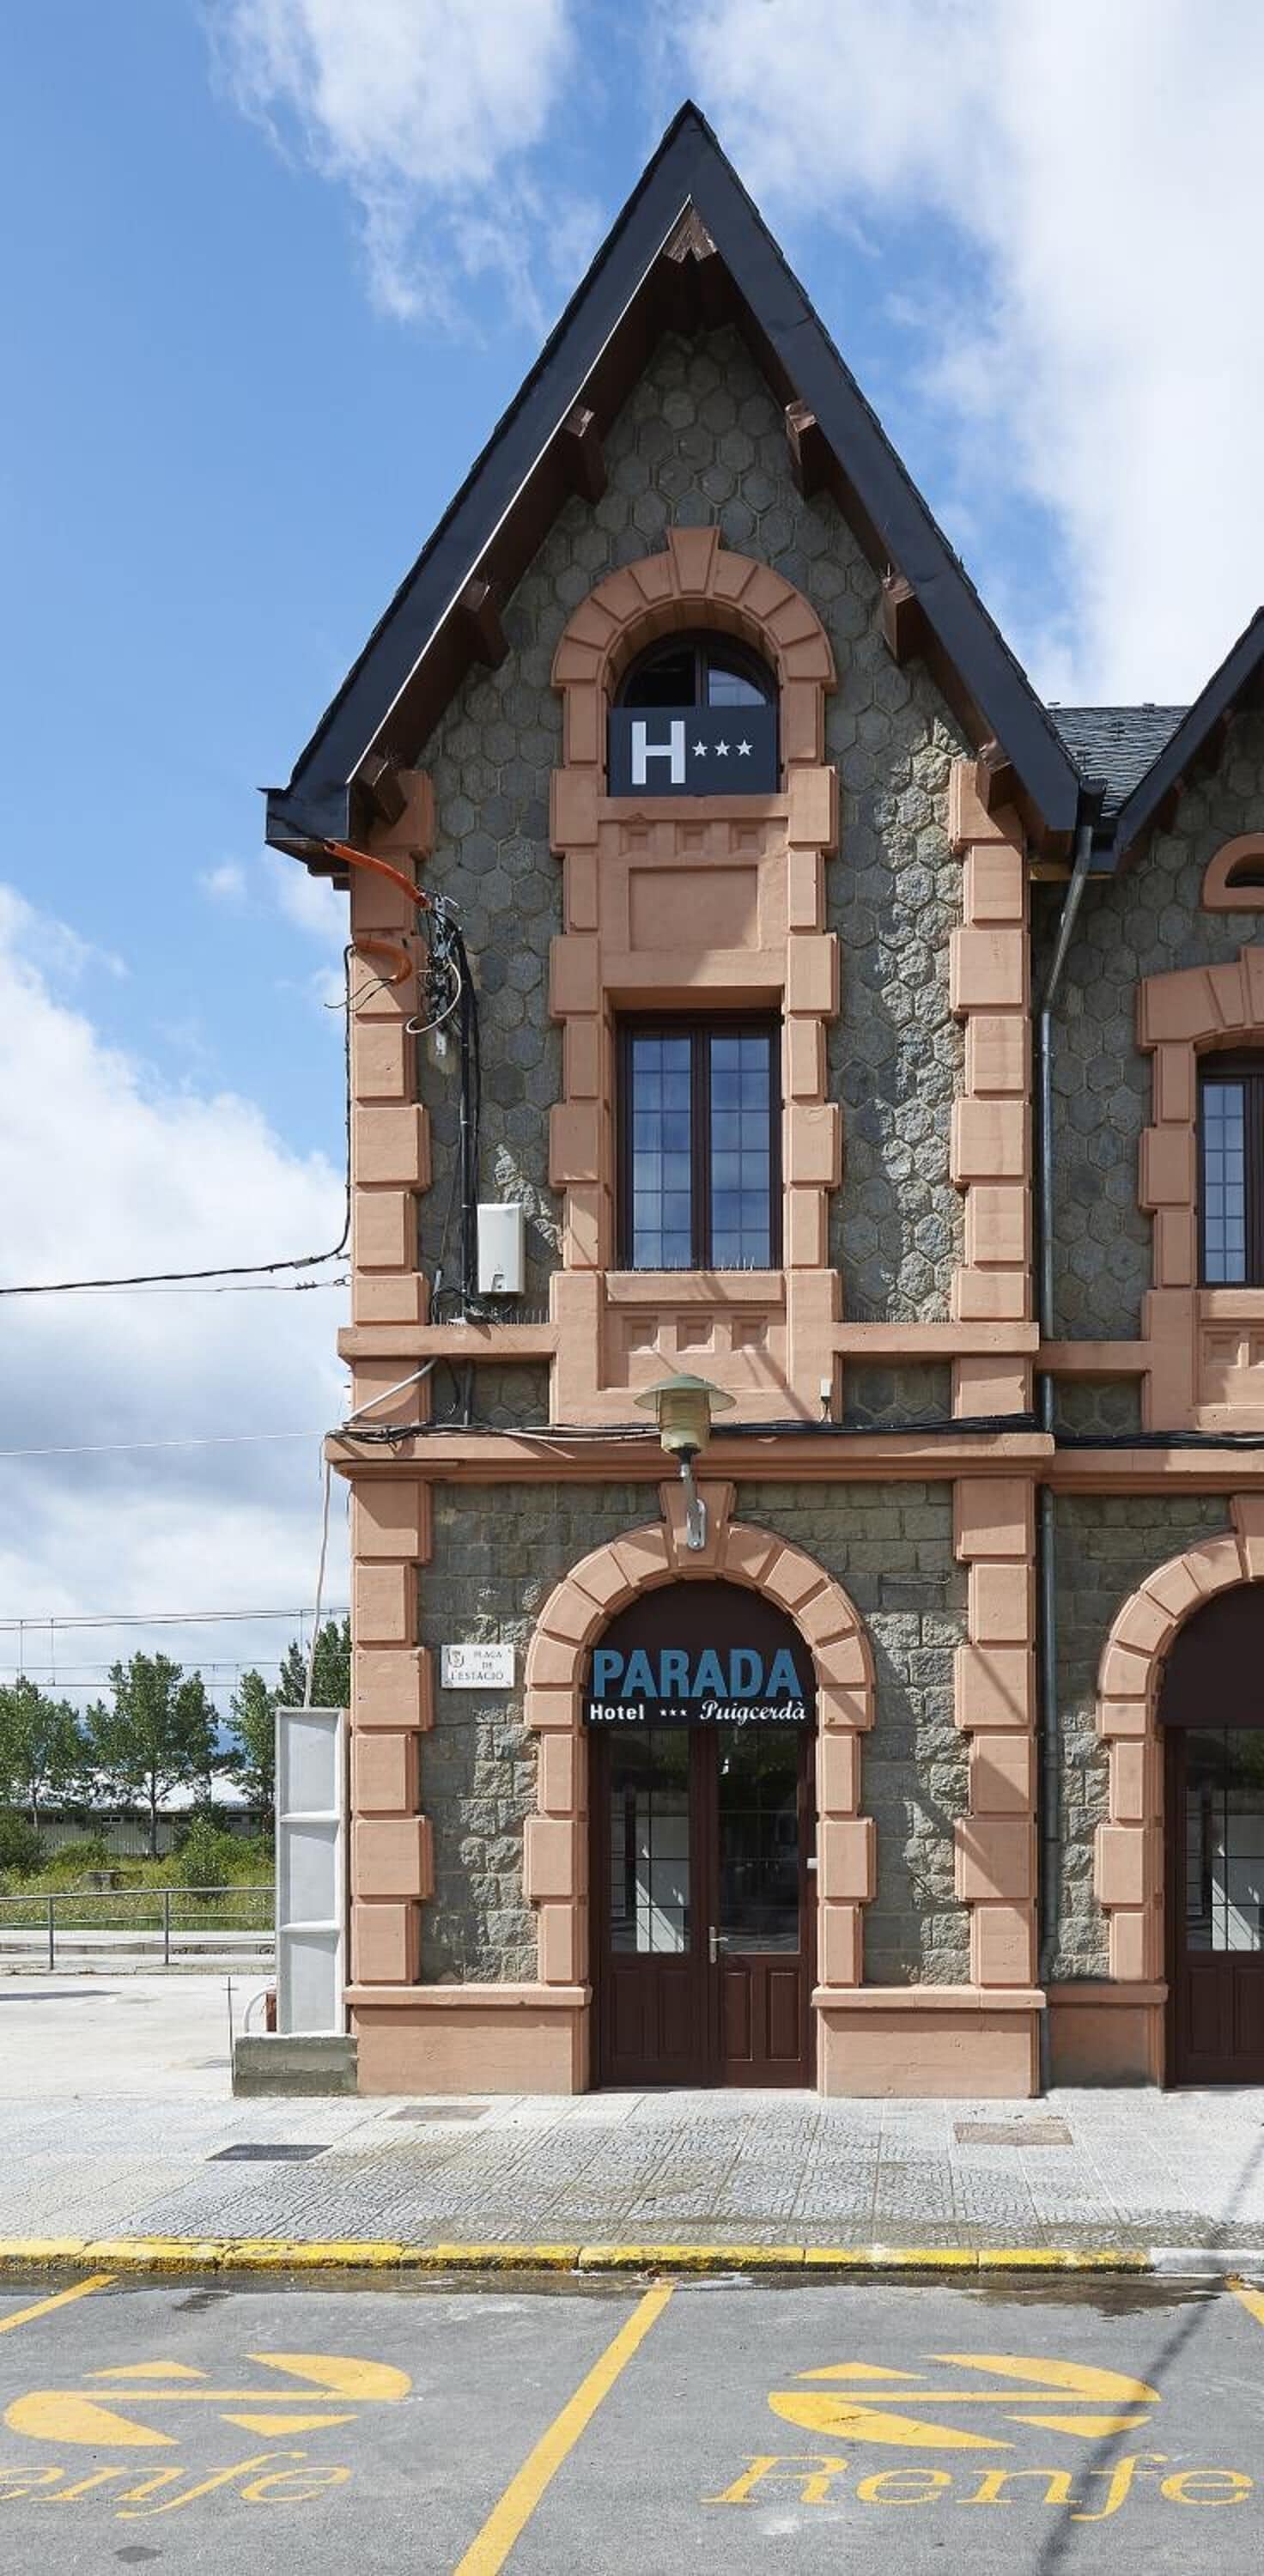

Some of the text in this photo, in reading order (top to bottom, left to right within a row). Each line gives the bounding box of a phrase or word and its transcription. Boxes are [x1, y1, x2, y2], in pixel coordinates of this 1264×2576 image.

[631, 720, 686, 785] H
[592, 1648, 804, 1698] PARADA
[590, 1700, 806, 1727] Hotel Puigcerdà
[0, 2451, 352, 2519] enfe
[700, 2453, 1254, 2522] Renfe
